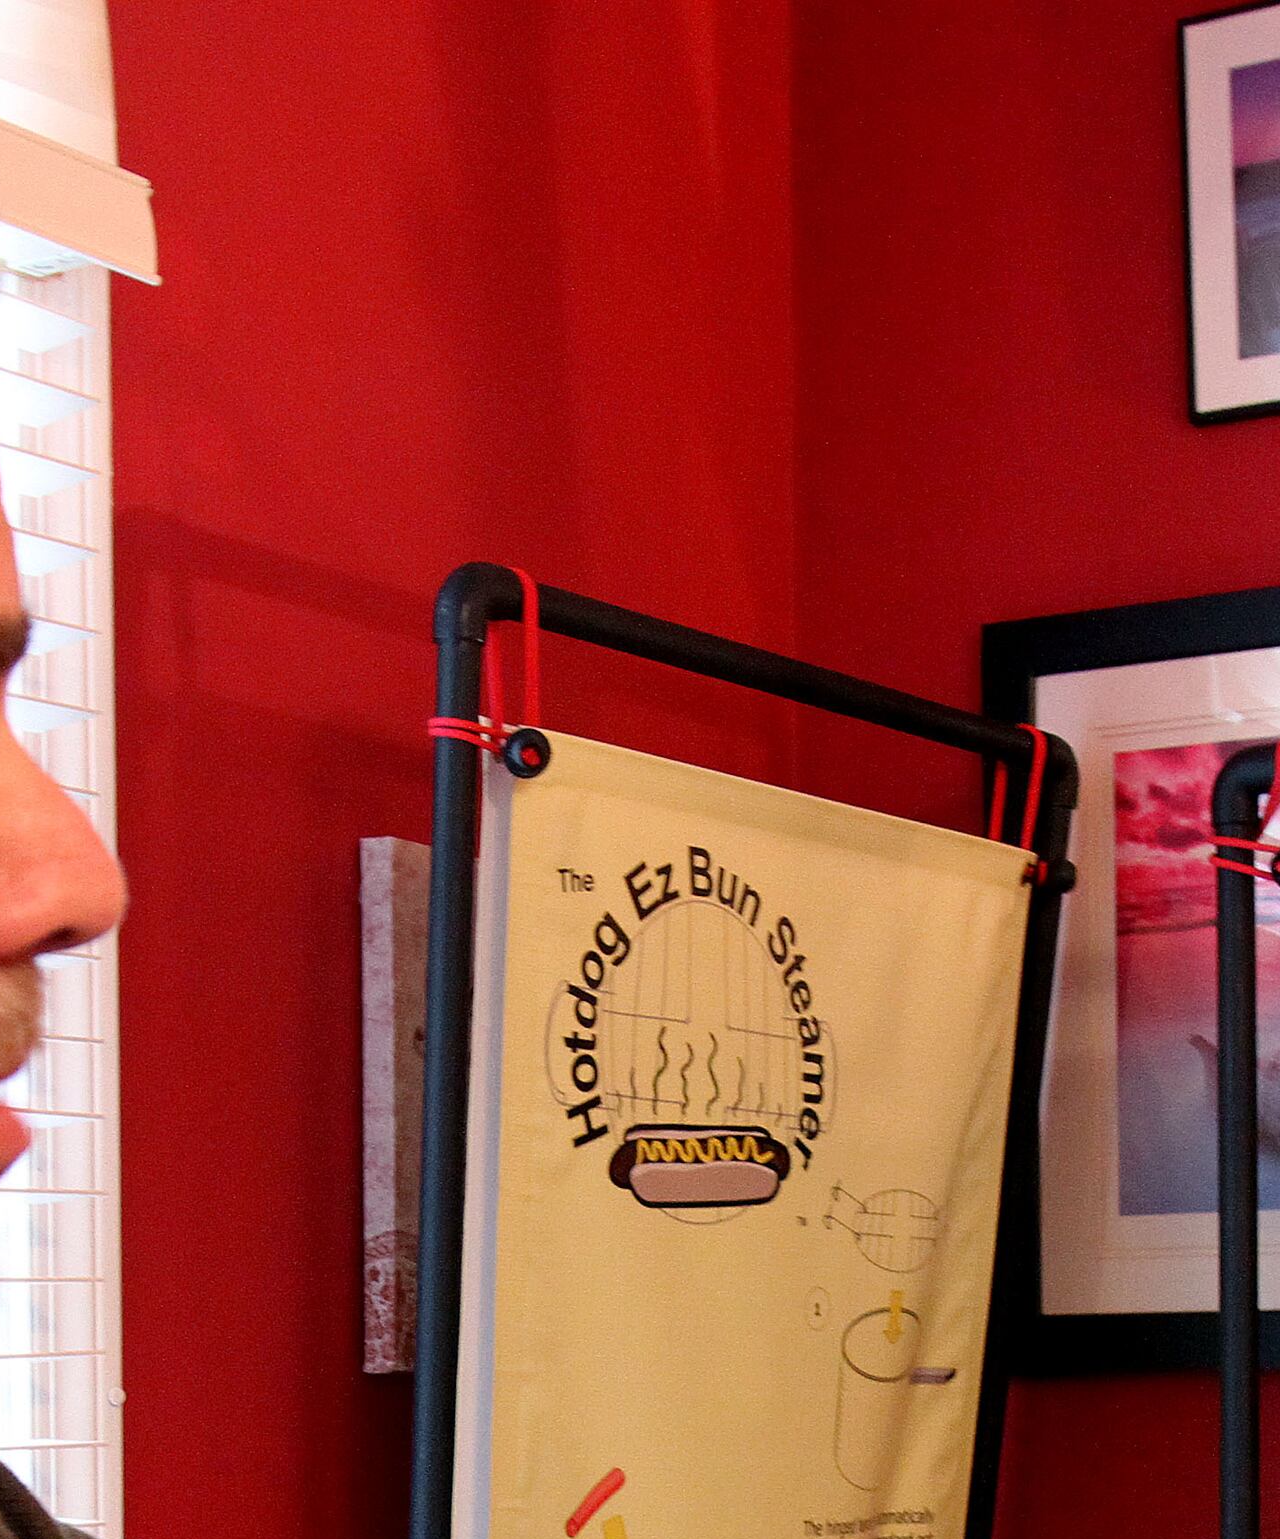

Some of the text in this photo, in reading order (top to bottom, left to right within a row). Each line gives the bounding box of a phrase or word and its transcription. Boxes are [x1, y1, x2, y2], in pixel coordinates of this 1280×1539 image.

[557, 867, 595, 893] The
[564, 846, 826, 1171] Hotdog Ez Bun Steamer
